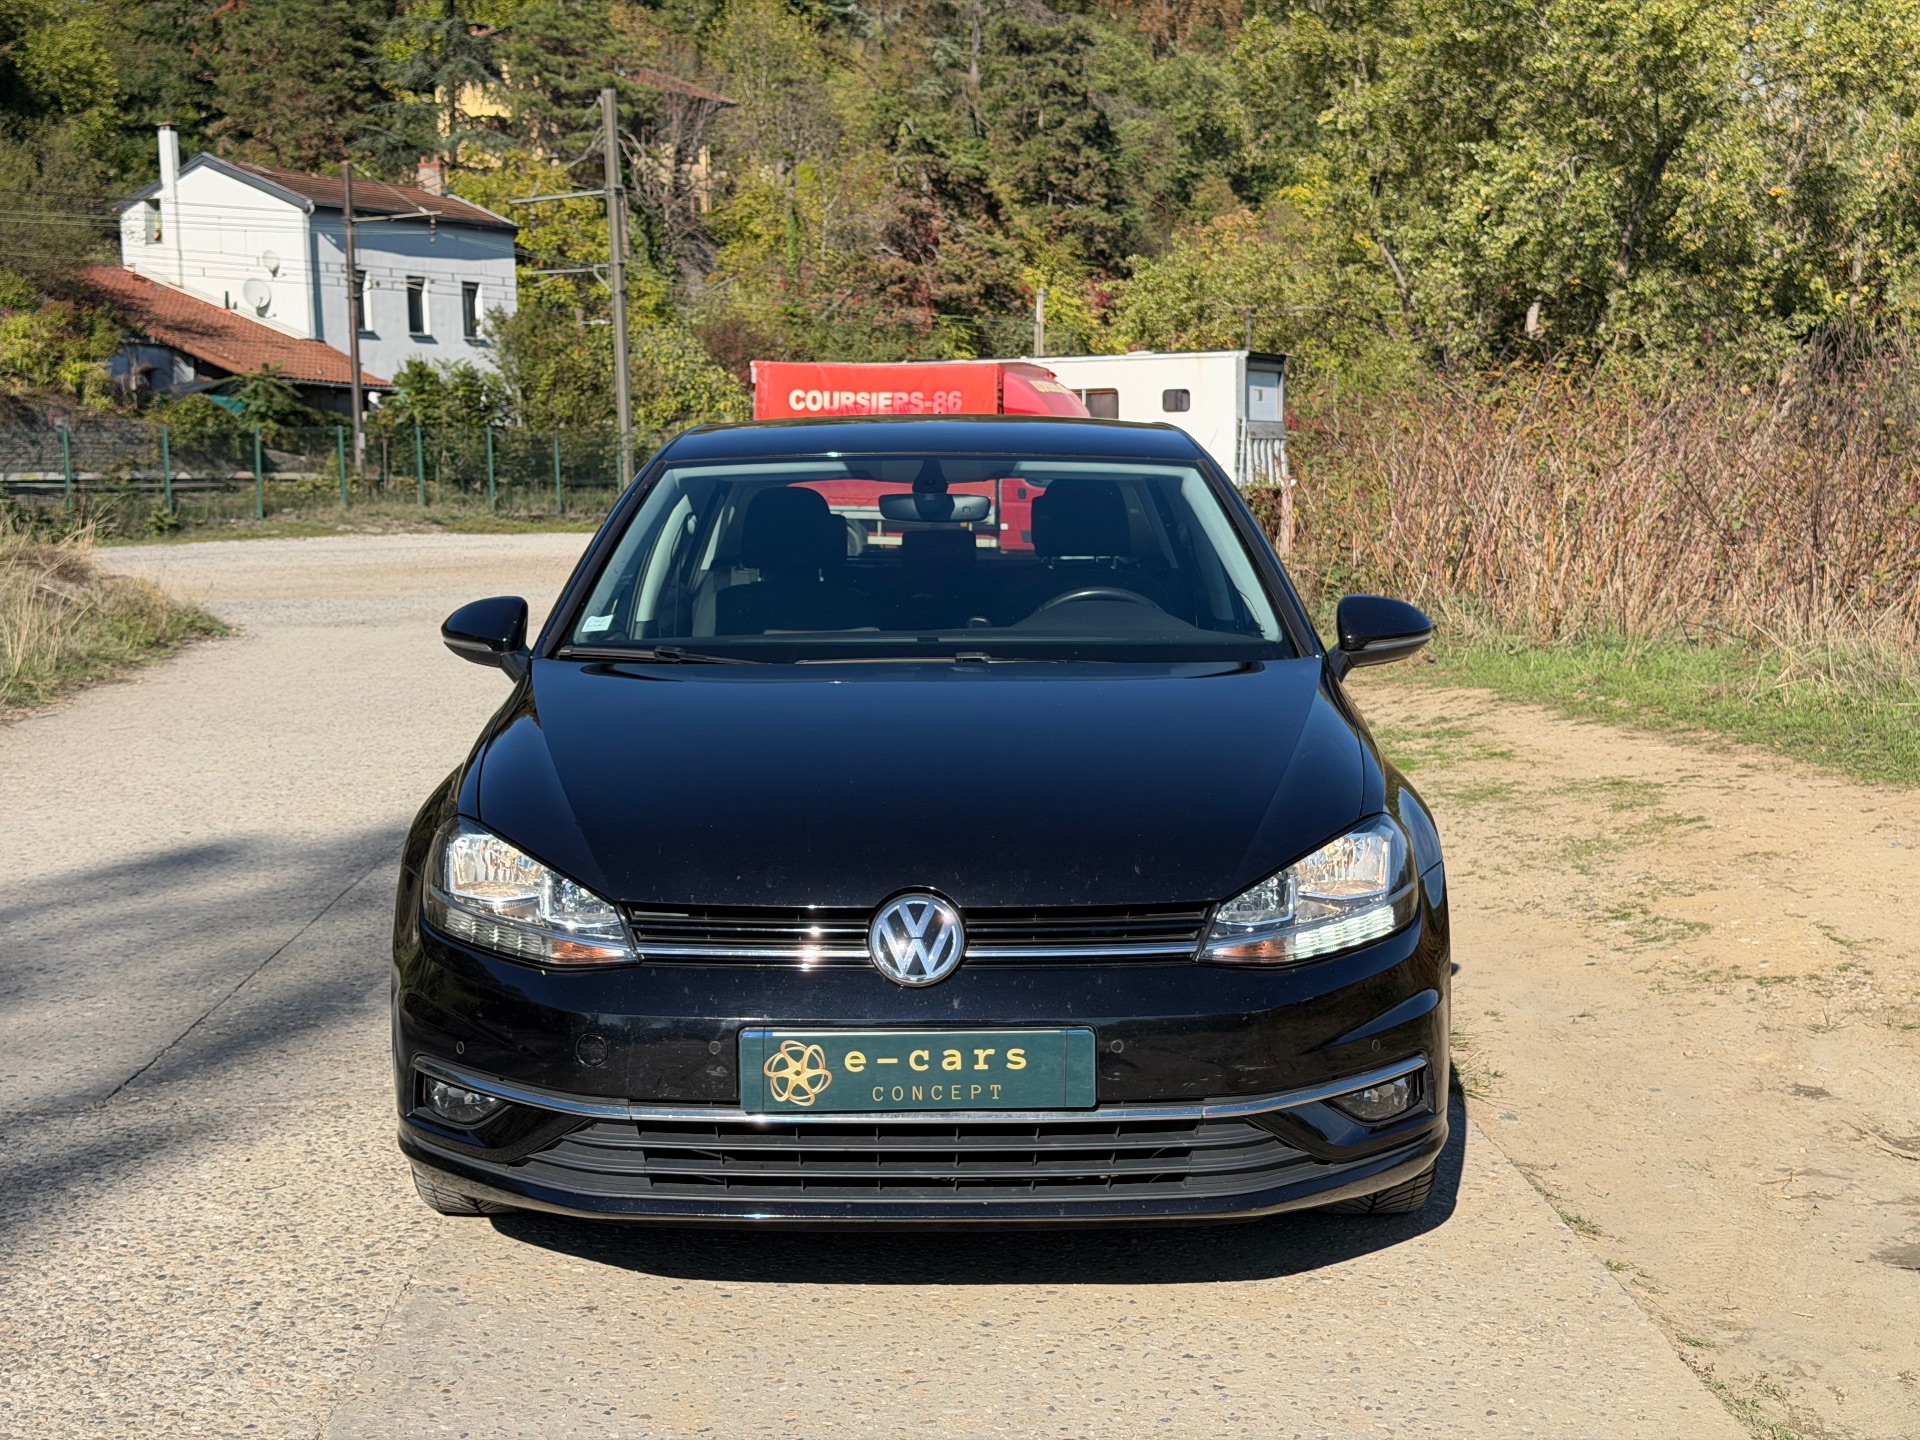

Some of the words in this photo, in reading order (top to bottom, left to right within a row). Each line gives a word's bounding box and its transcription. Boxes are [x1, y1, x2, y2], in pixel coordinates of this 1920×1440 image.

[788, 389, 963, 415] COURSIERS-86
[876, 897, 957, 982] VW
[844, 1048, 1027, 1073] e-cars
[872, 1084, 1002, 1102] CONCEPT
